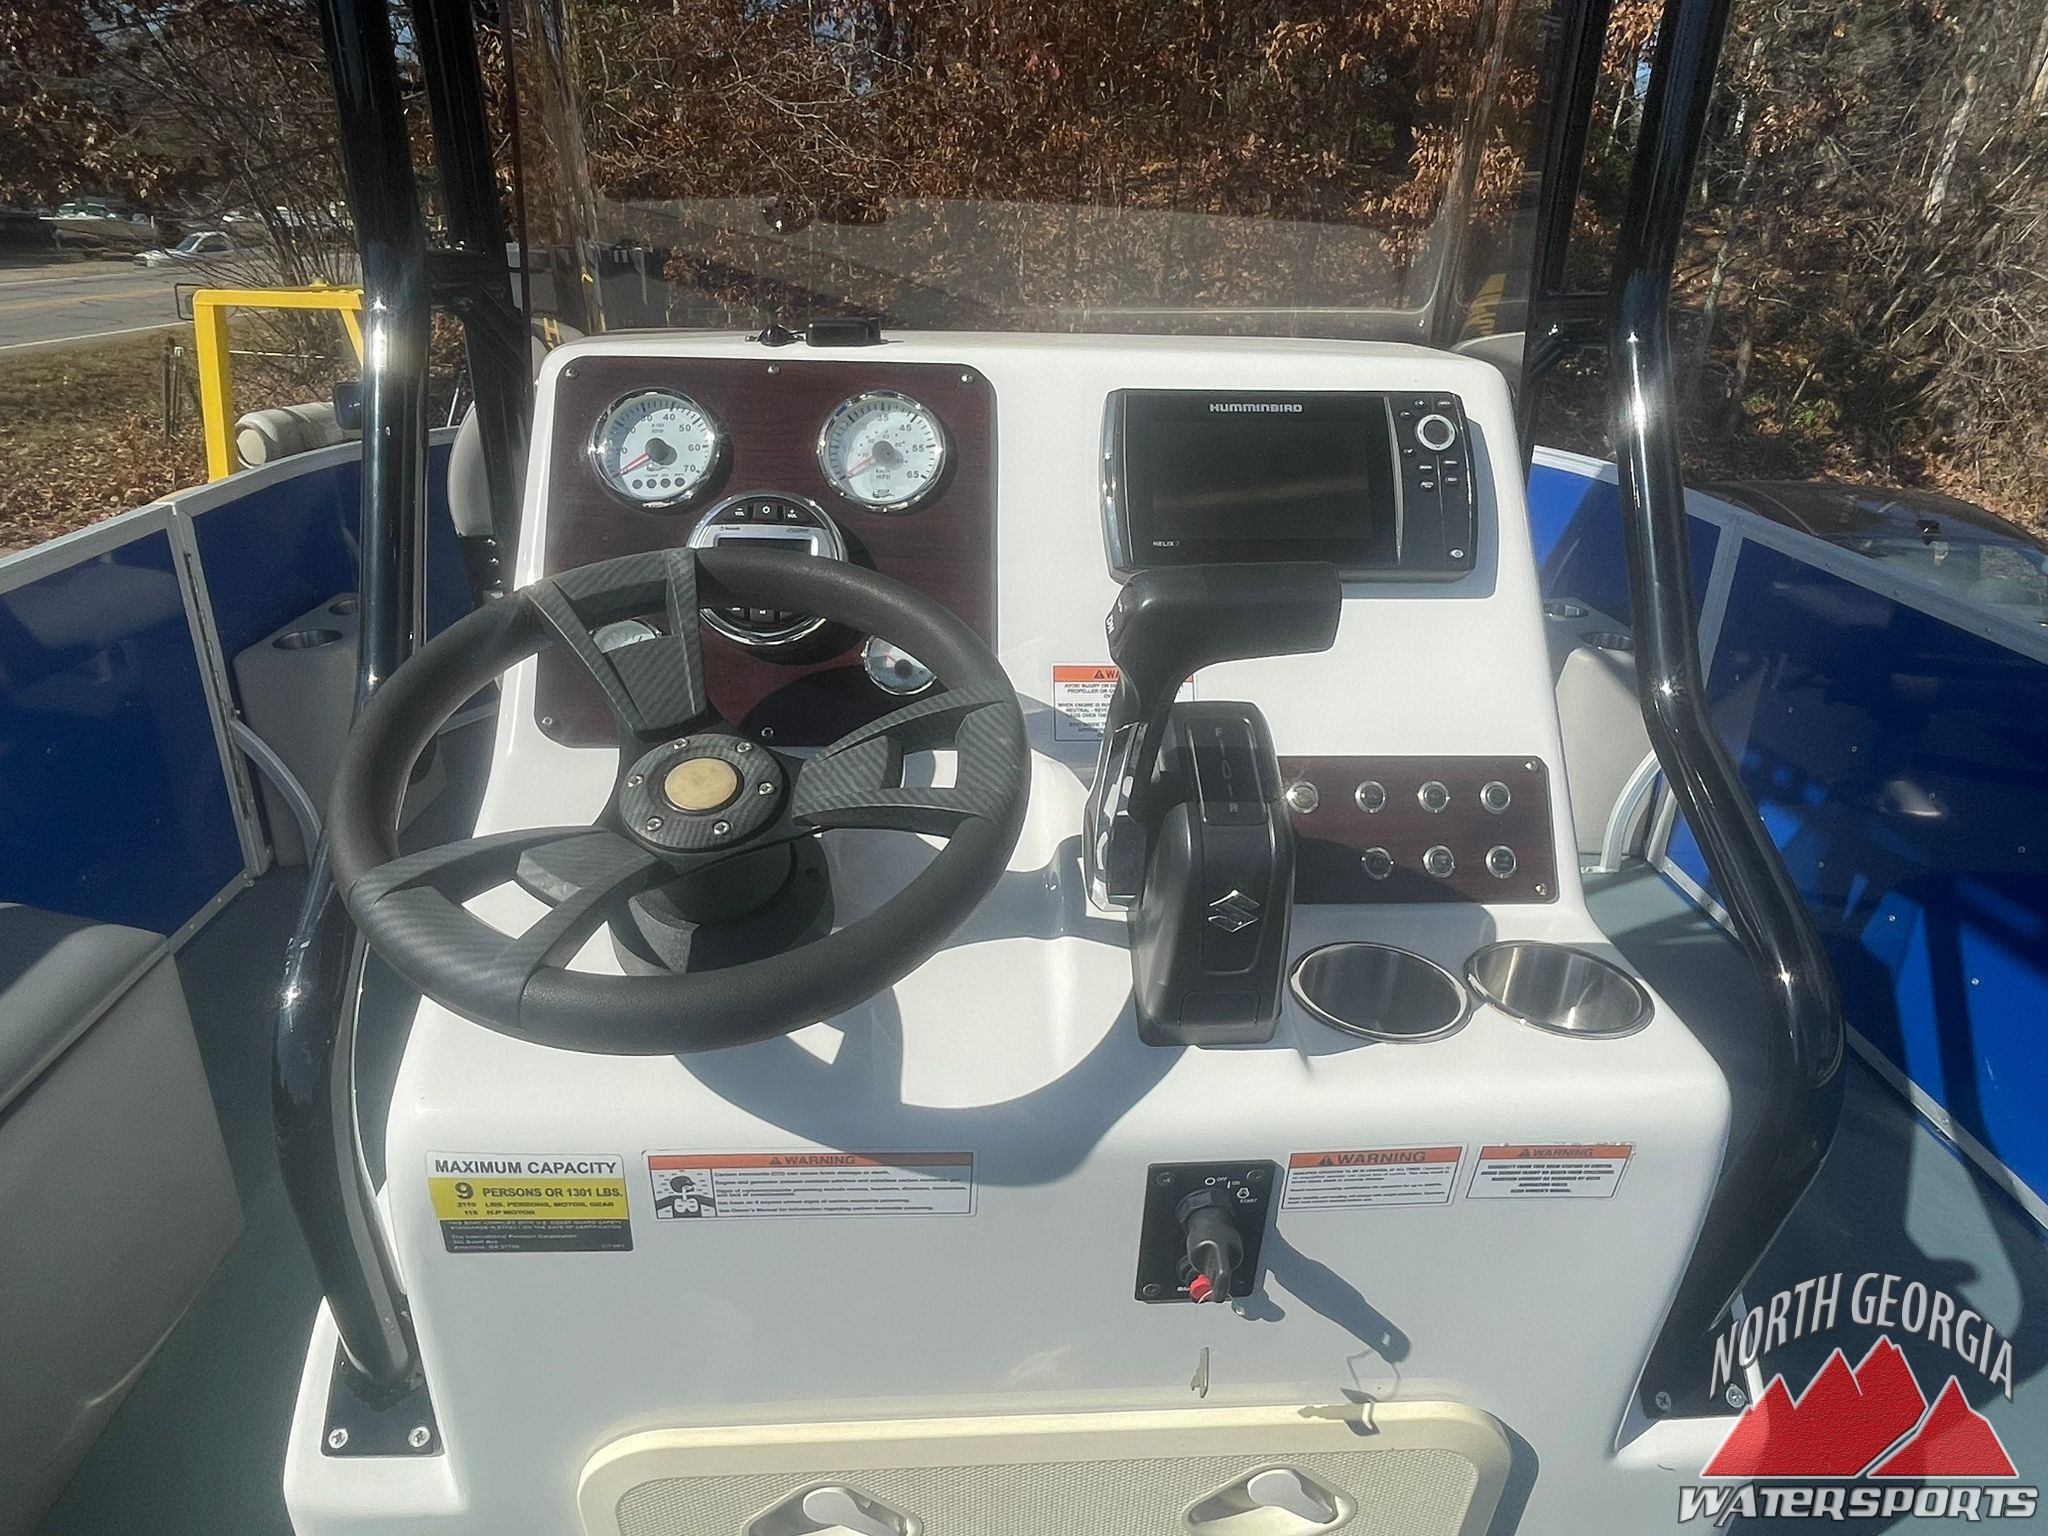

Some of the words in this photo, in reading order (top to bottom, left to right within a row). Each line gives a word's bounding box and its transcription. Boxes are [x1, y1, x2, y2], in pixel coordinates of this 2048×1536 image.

[1209, 403, 1303, 413] HUMMINBIRD
[662, 413, 676, 422] 40
[679, 424, 692, 433] 50
[899, 424, 912, 432] 45
[688, 443, 701, 452] 60
[911, 444, 925, 453] 55
[683, 464, 697, 473] 70
[906, 470, 920, 479] 65
[1228, 802, 1239, 813] R
[1532, 1147, 1594, 1157] WARNING
[784, 1155, 856, 1165] WARNING
[1337, 1151, 1426, 1165] WARNING
[434, 1159, 522, 1174] MAXIMUM
[527, 1161, 617, 1175] CAPACITY
[454, 1181, 474, 1200] 9
[482, 1187, 543, 1198] PERSONS
[545, 1187, 564, 1198] OR
[566, 1187, 593, 1198] 1301
[596, 1187, 623, 1198] LBS.
